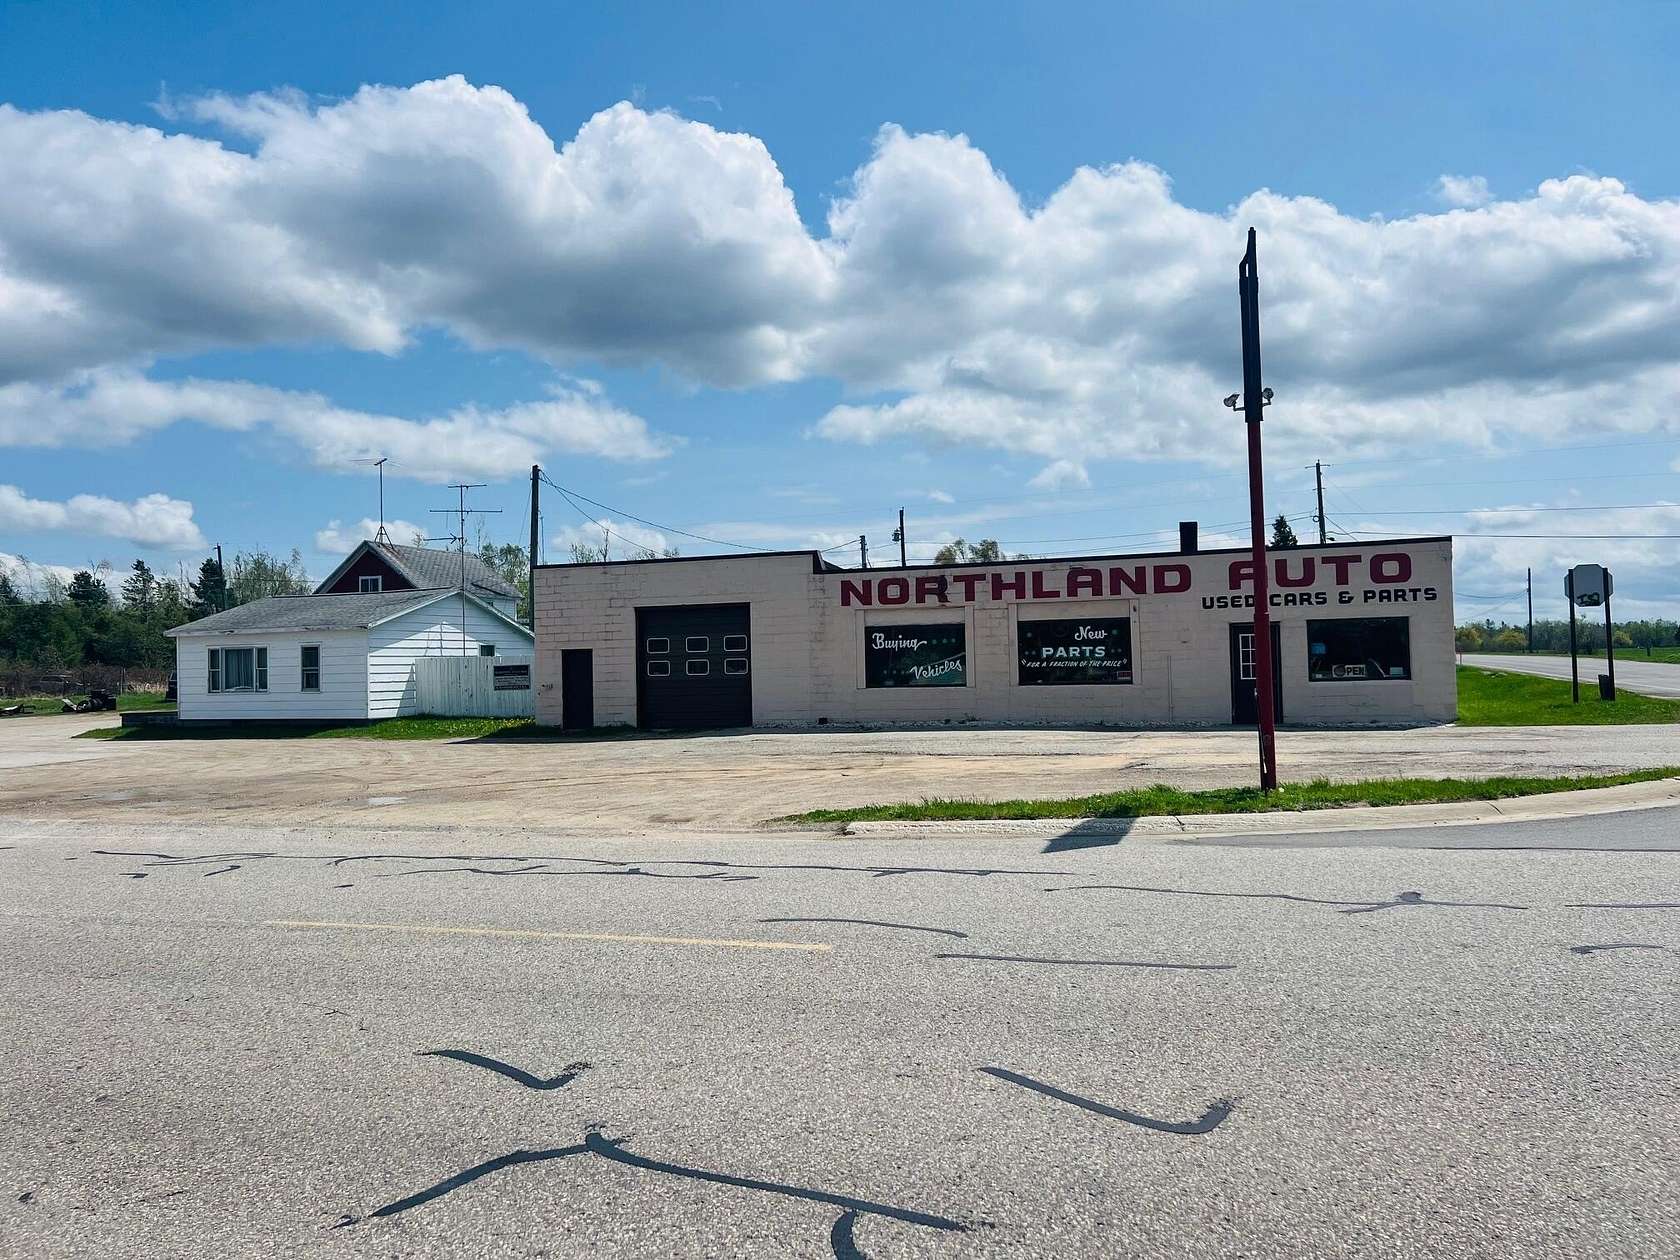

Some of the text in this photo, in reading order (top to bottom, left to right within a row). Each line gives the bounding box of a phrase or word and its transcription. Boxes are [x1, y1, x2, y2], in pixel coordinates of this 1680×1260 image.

[840, 553, 1412, 607] NORTHLAND AUTO
[1202, 587, 1437, 609] USED CARS & PARTS
[872, 633, 927, 651] Buying
[1074, 626, 1108, 640] New
[1042, 646, 1106, 658] PARTS
[909, 660, 962, 679] Vehicles
[1334, 665, 1365, 678] OPEN
